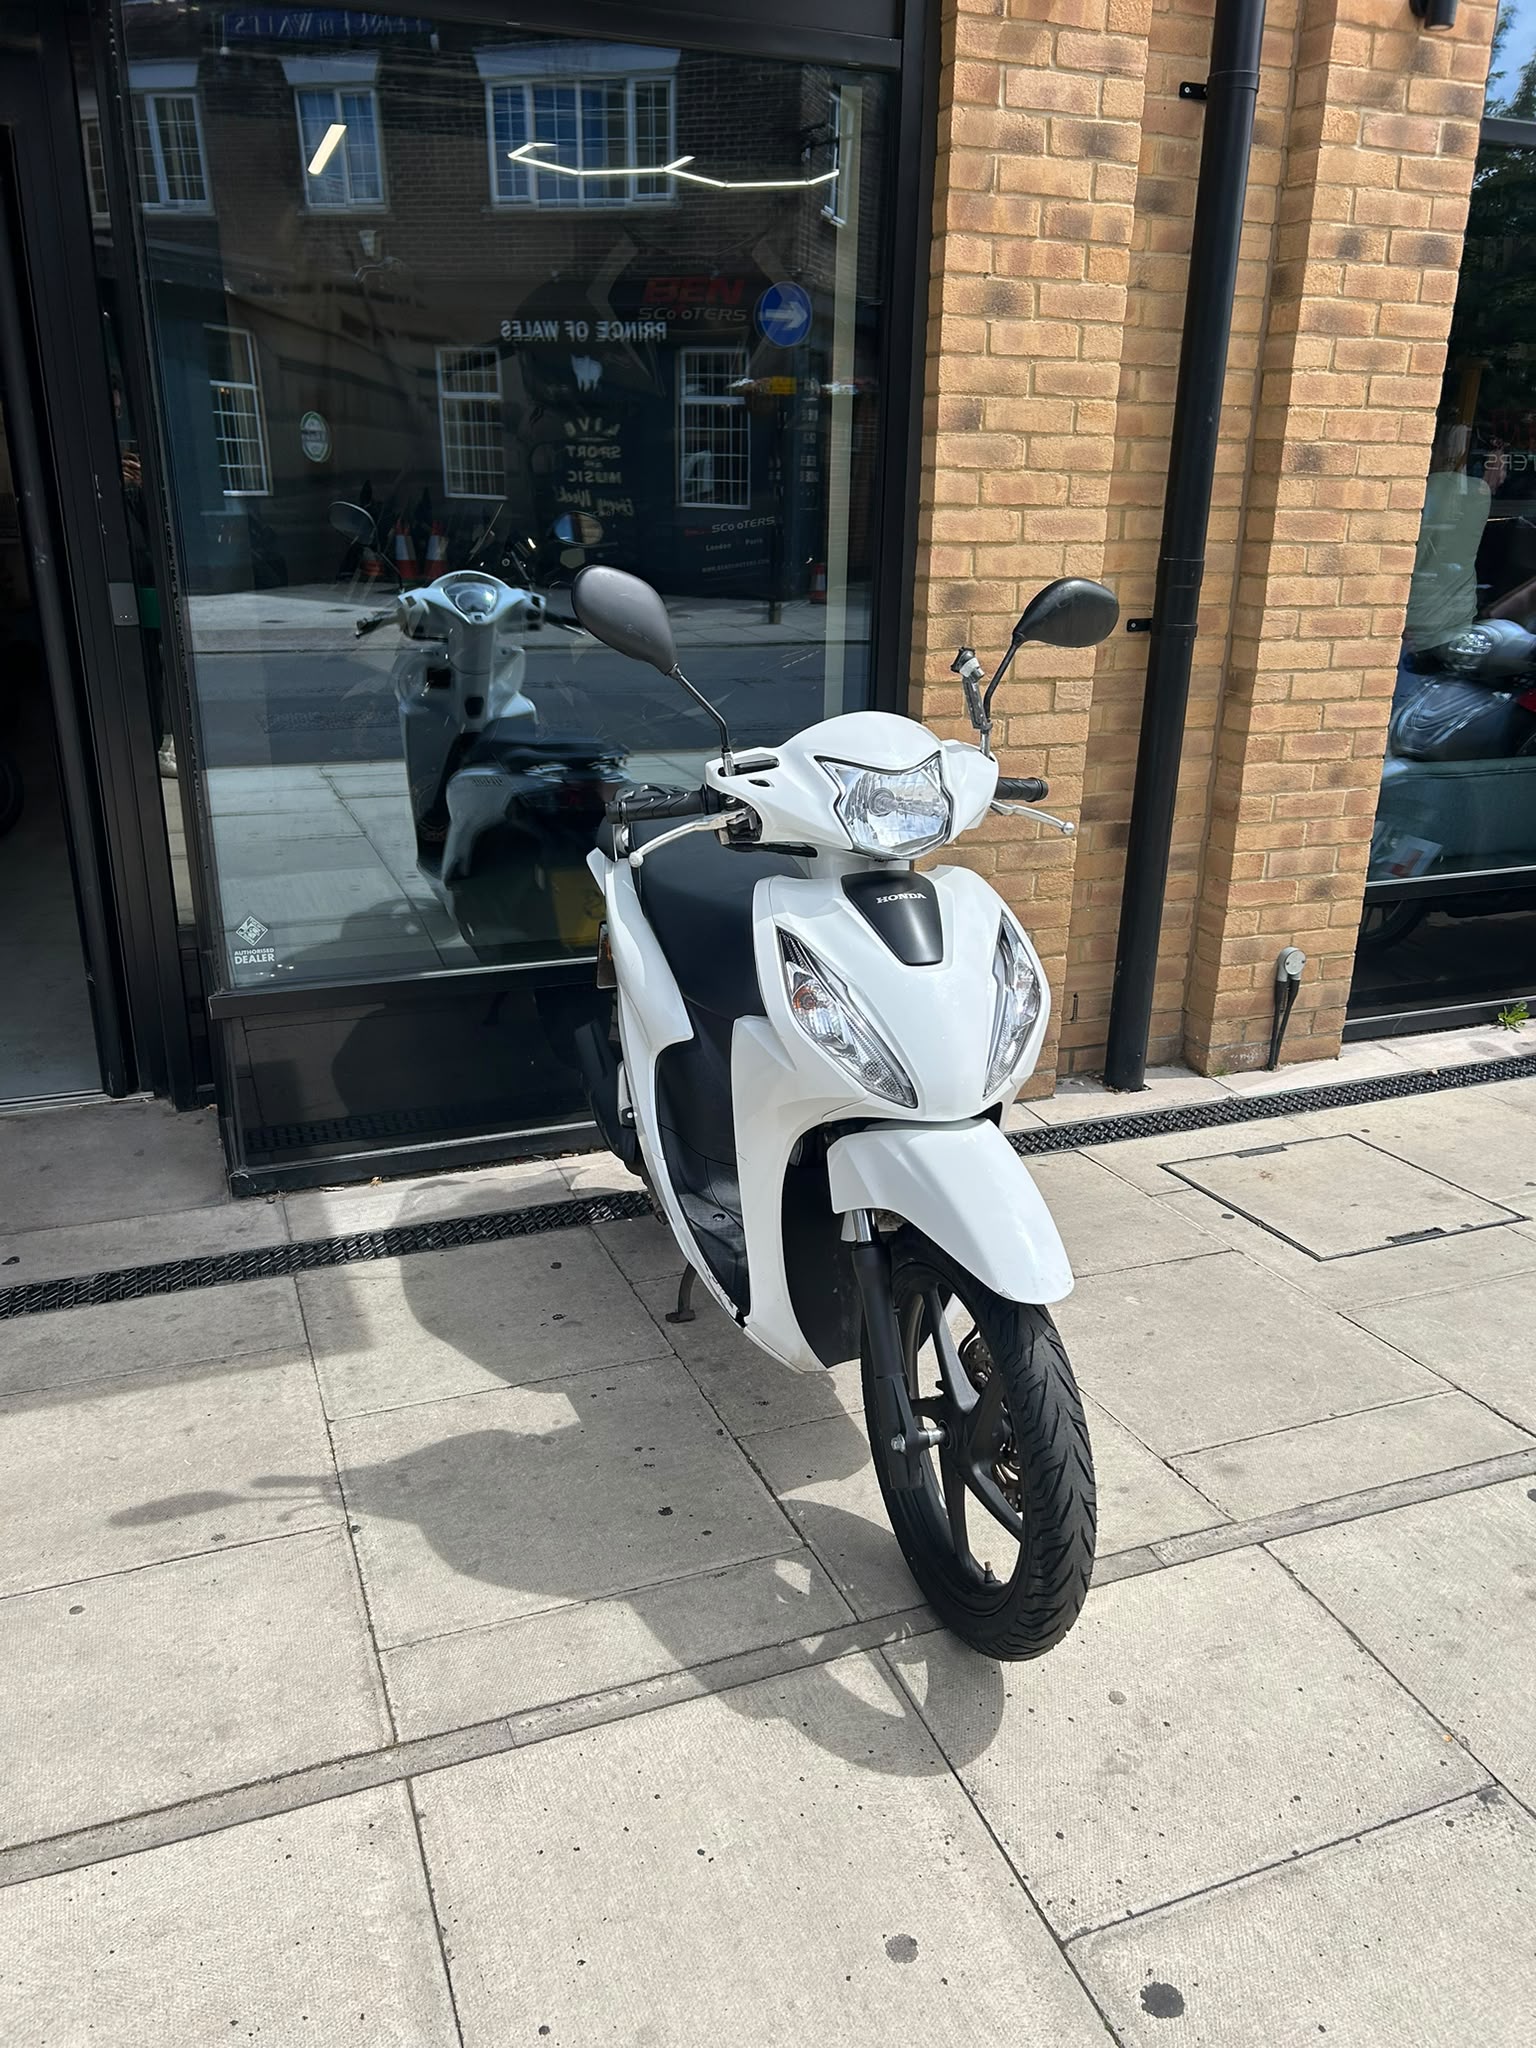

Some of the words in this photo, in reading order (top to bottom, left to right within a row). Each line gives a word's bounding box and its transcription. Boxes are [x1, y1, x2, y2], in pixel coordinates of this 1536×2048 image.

[644, 277, 744, 304] BEN
[876, 892, 927, 904] HONDA
[234, 947, 275, 956] AUTHORISED
[234, 953, 275, 965] DEALER
